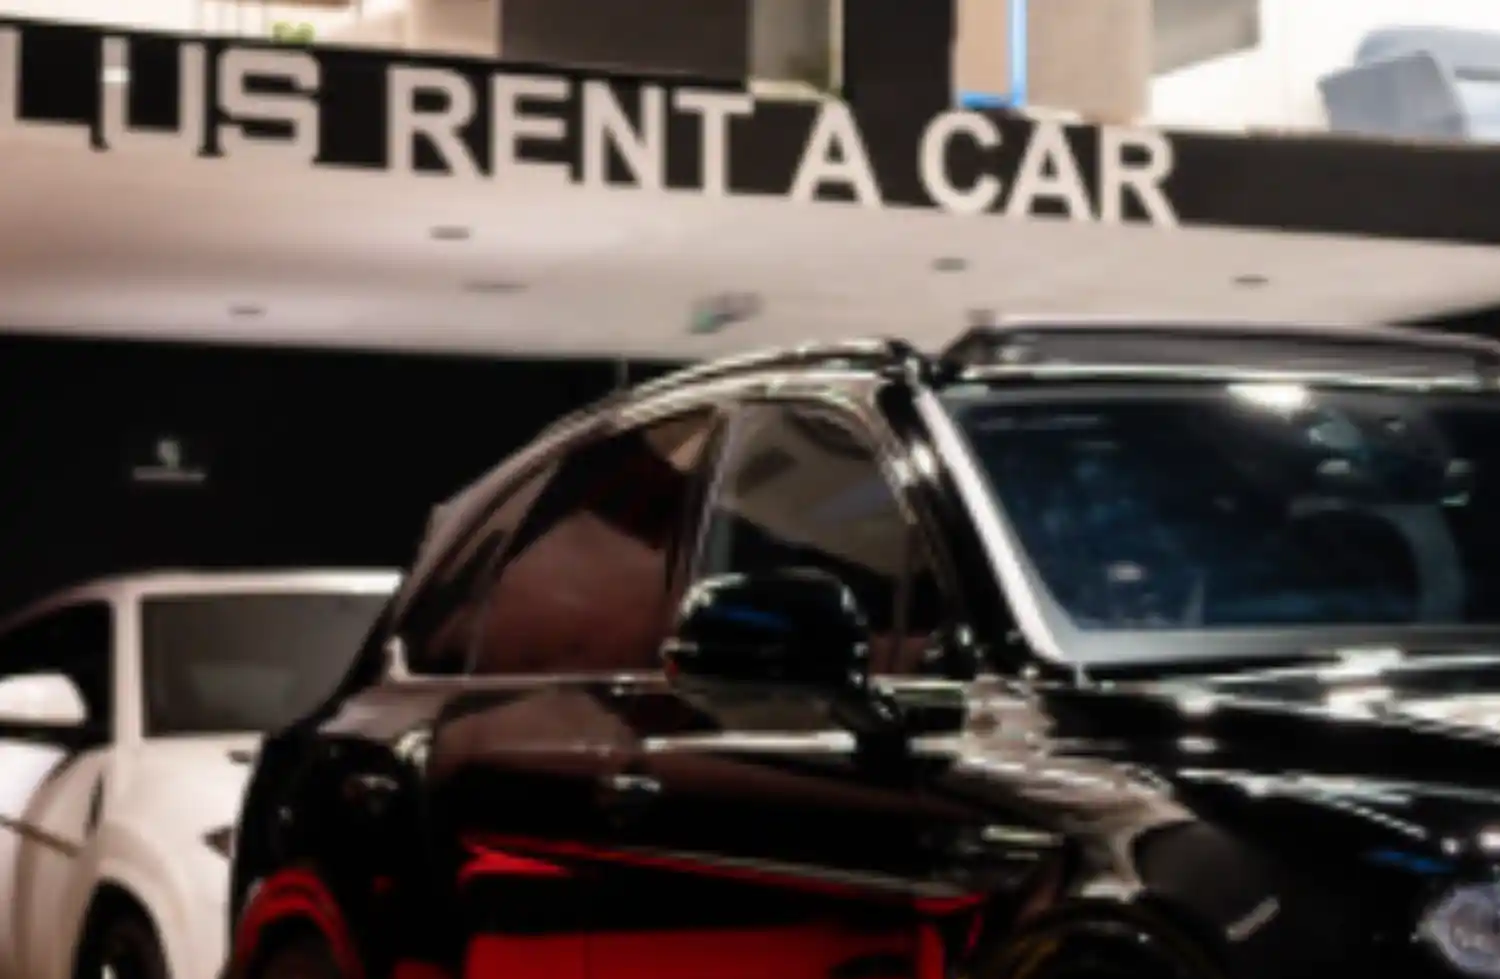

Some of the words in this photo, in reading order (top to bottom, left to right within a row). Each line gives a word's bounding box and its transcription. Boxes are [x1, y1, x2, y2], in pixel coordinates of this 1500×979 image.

[387, 63, 755, 197] RENT
[788, 99, 884, 208] A
[917, 107, 1181, 227] CAR
